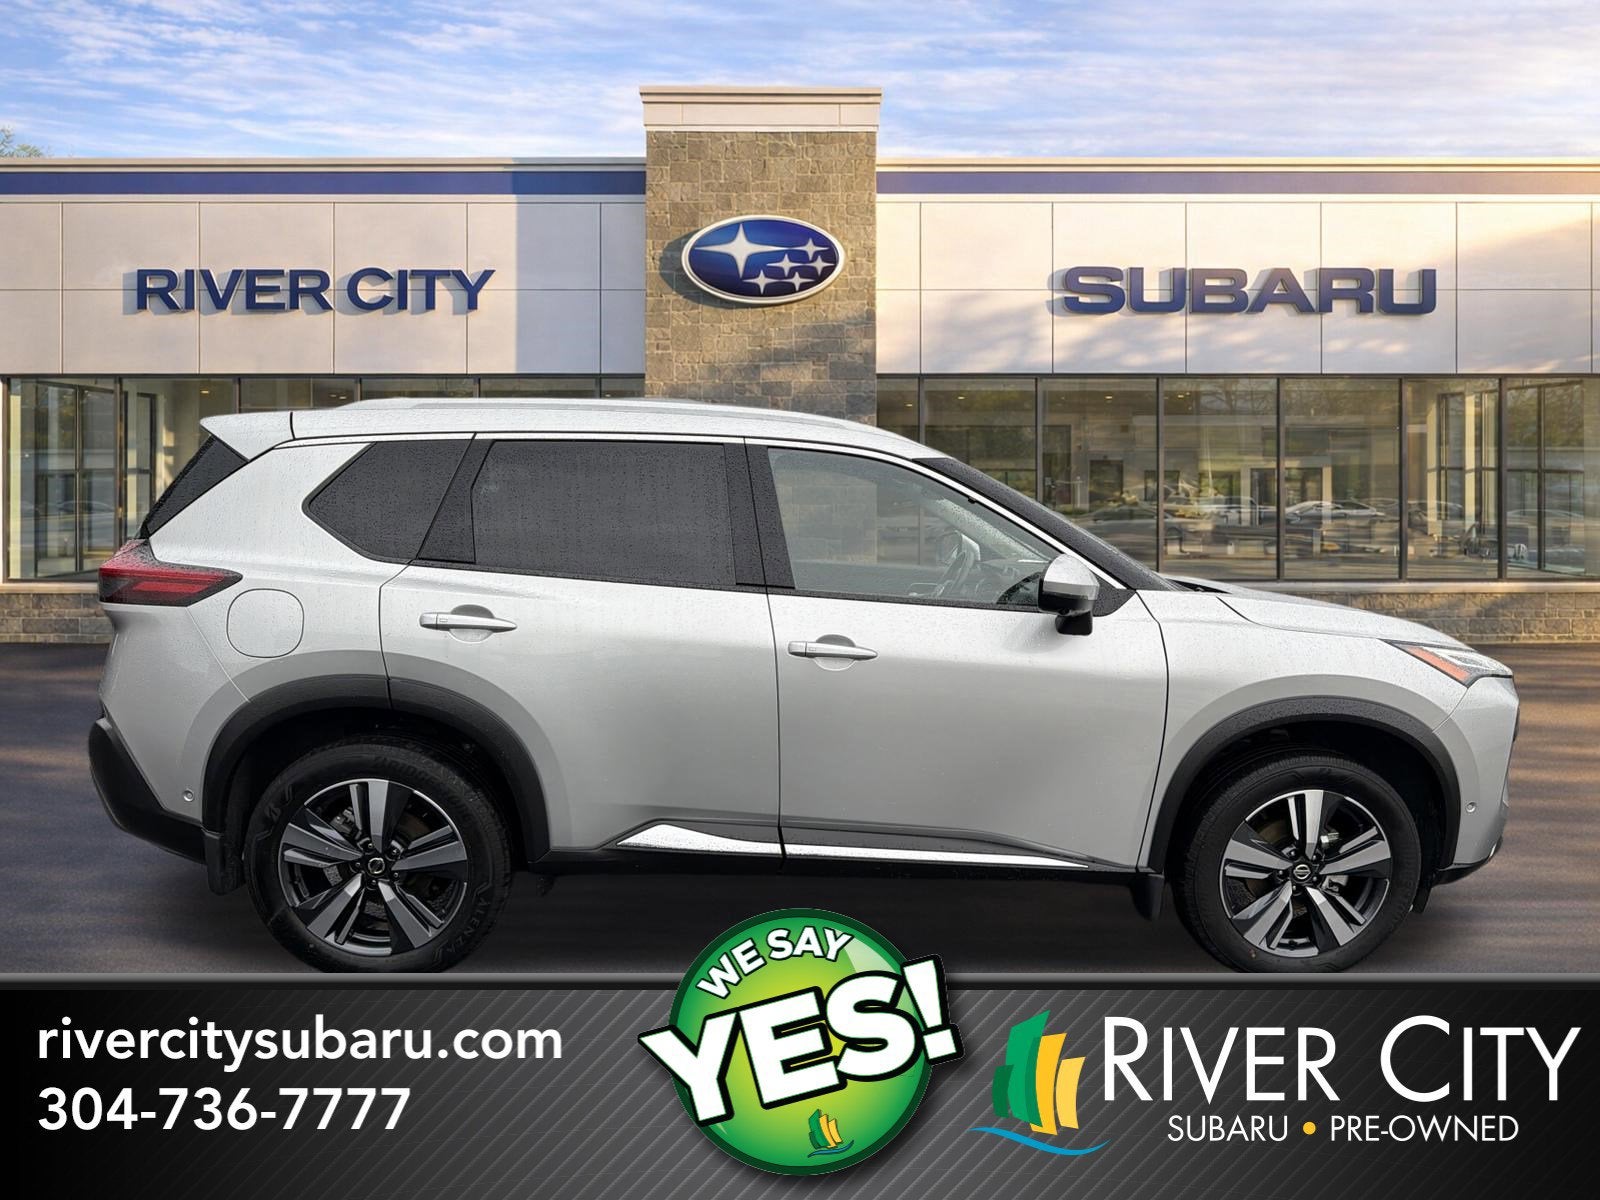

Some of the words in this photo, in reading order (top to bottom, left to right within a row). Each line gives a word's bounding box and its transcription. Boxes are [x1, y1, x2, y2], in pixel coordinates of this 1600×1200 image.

[136, 269, 335, 311] RIVER
[347, 267, 496, 311] CITY
[1063, 266, 1437, 314] SUBARU
